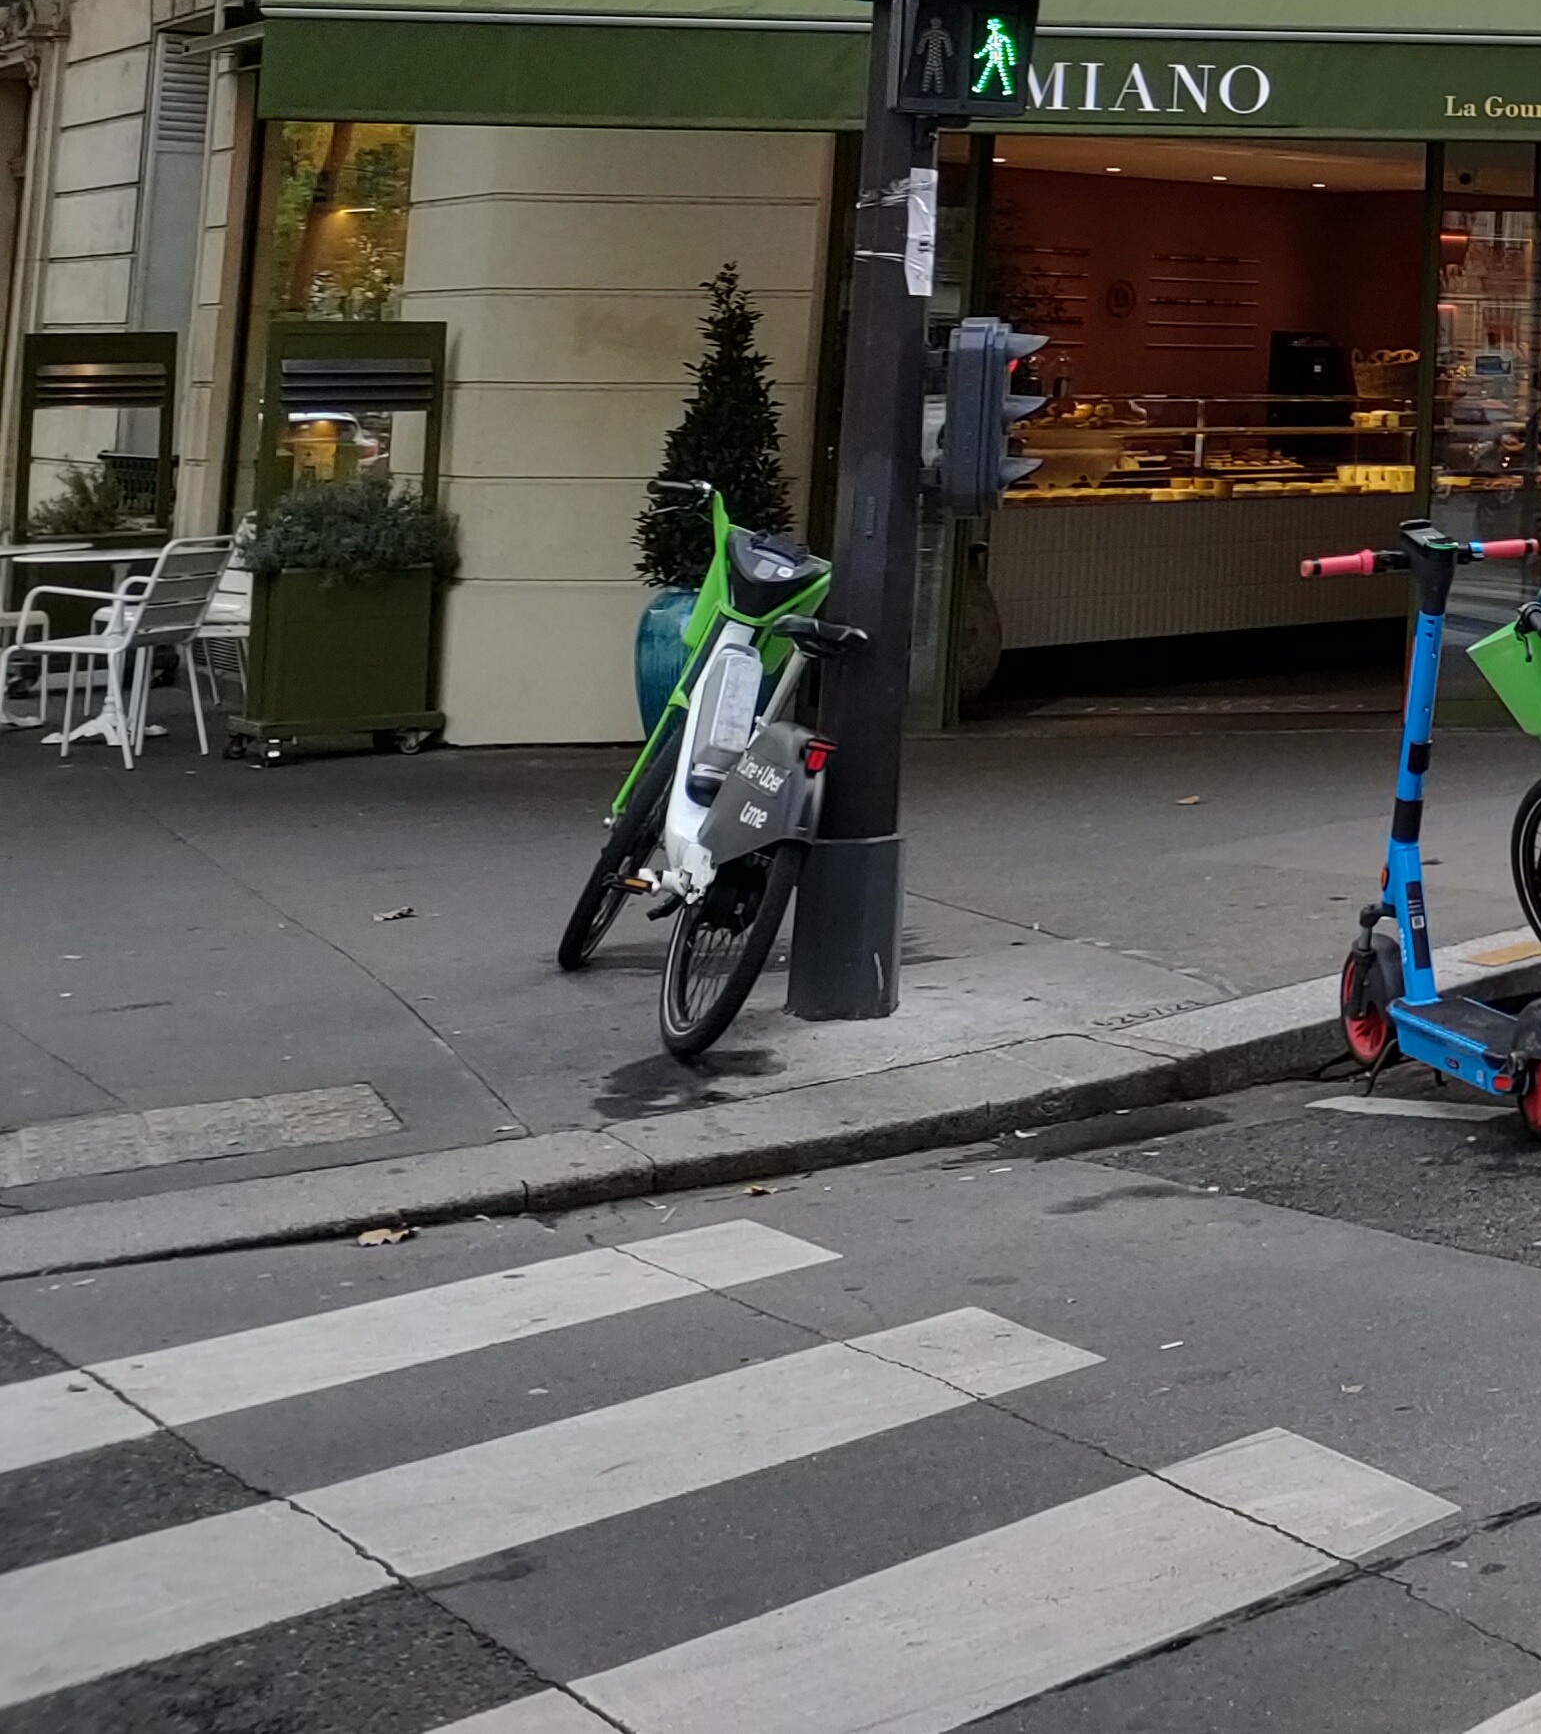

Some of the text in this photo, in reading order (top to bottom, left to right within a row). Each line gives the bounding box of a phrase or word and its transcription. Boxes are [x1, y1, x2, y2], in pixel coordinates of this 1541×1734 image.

[1026, 62, 1270, 114] MIANO
[1444, 95, 1477, 117] La
[759, 766, 785, 793] Uber
